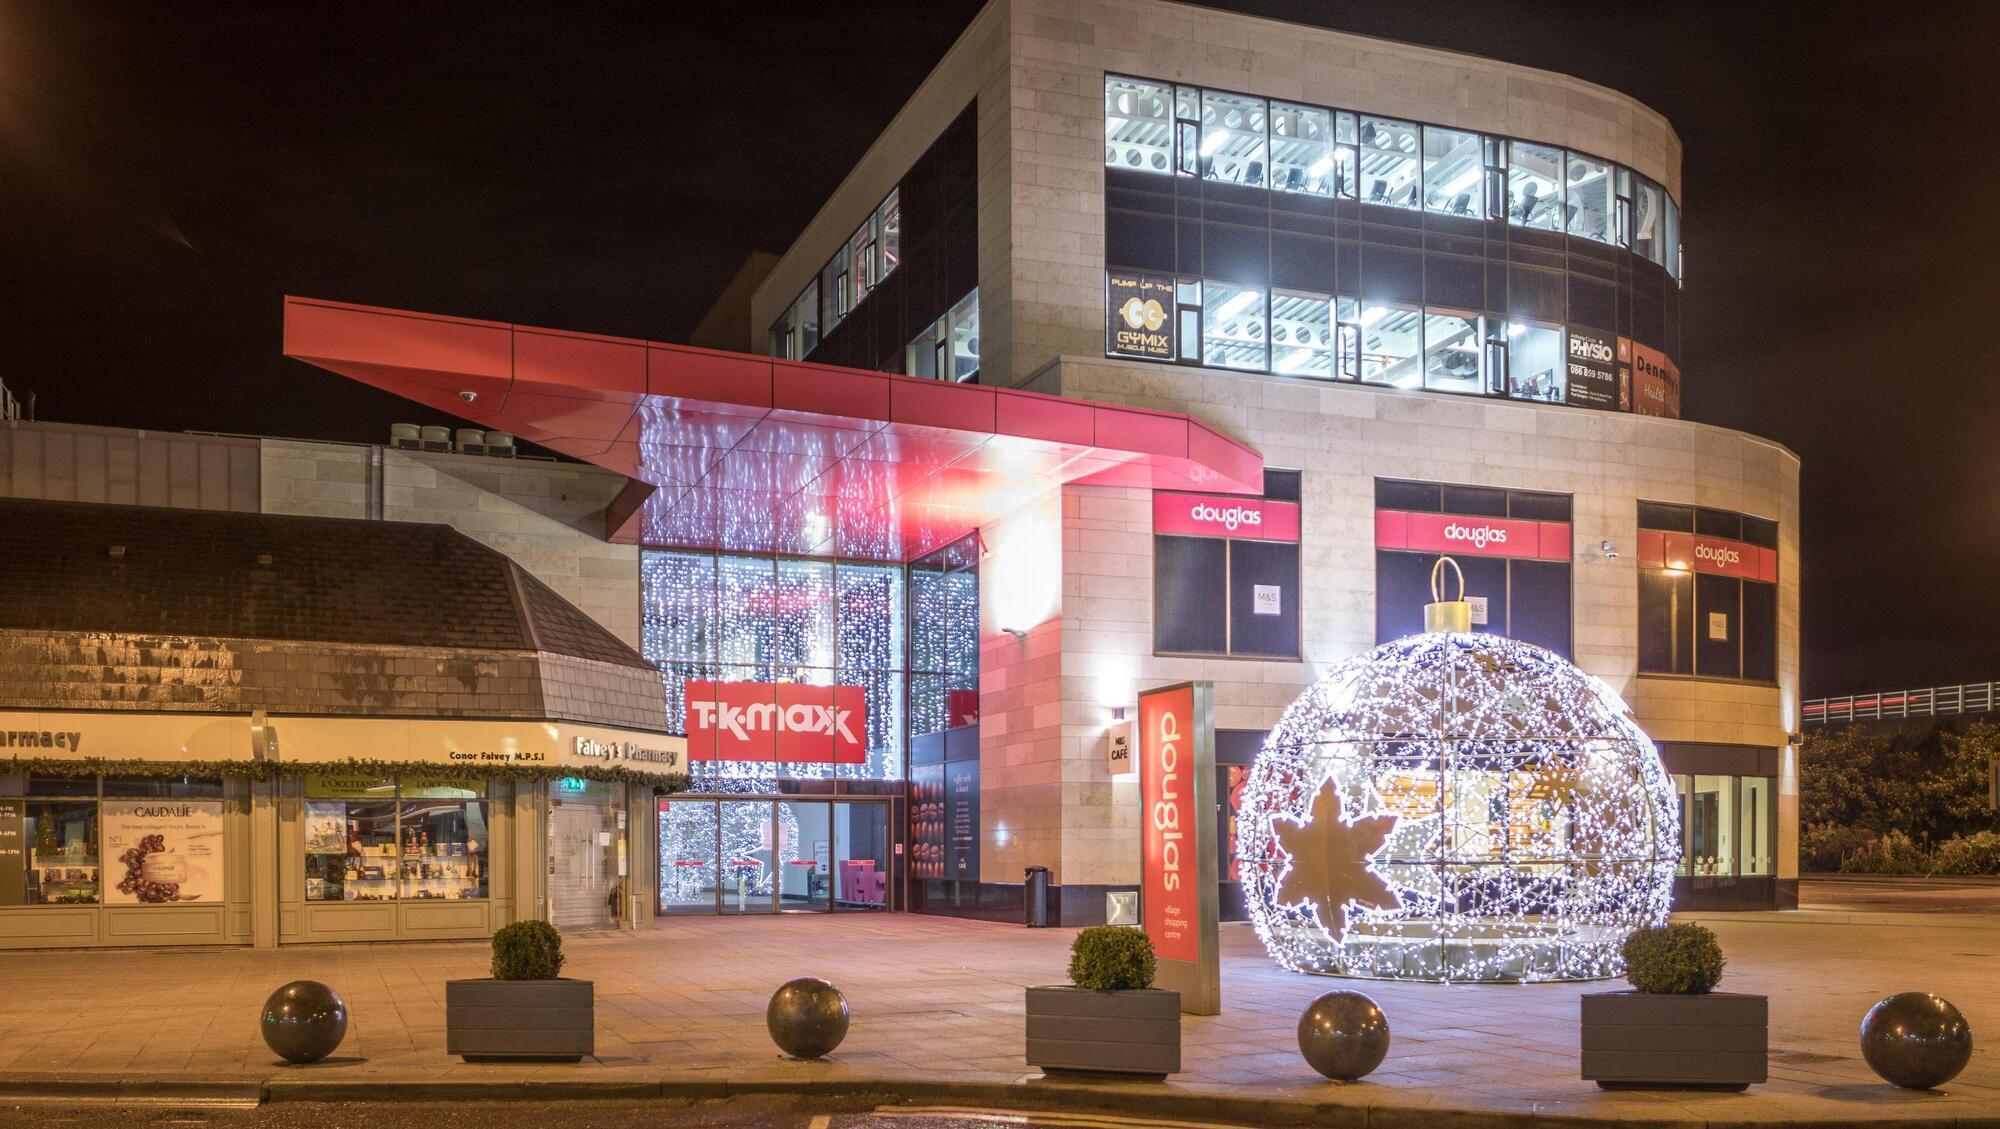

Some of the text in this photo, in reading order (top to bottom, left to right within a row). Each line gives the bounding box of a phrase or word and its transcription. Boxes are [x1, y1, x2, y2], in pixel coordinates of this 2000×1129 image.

[1111, 278, 1173, 293] PUMP UP THE
[1117, 331, 1168, 347] GYMIX
[1190, 502, 1262, 531] douglas
[1443, 522, 1507, 549] douglas
[1695, 543, 1740, 568] douglas
[1258, 591, 1277, 602] M&S
[449, 751, 477, 760] Conor
[480, 751, 511, 762] Falvey
[575, 735, 679, 767] Falvey's Pharmacy
[321, 779, 379, 789] L'OCCITANE
[1153, 711, 1183, 892] douglas
[1164, 905, 1180, 917] village
[1164, 918, 1188, 929] shopping
[1164, 931, 1181, 940] centre
